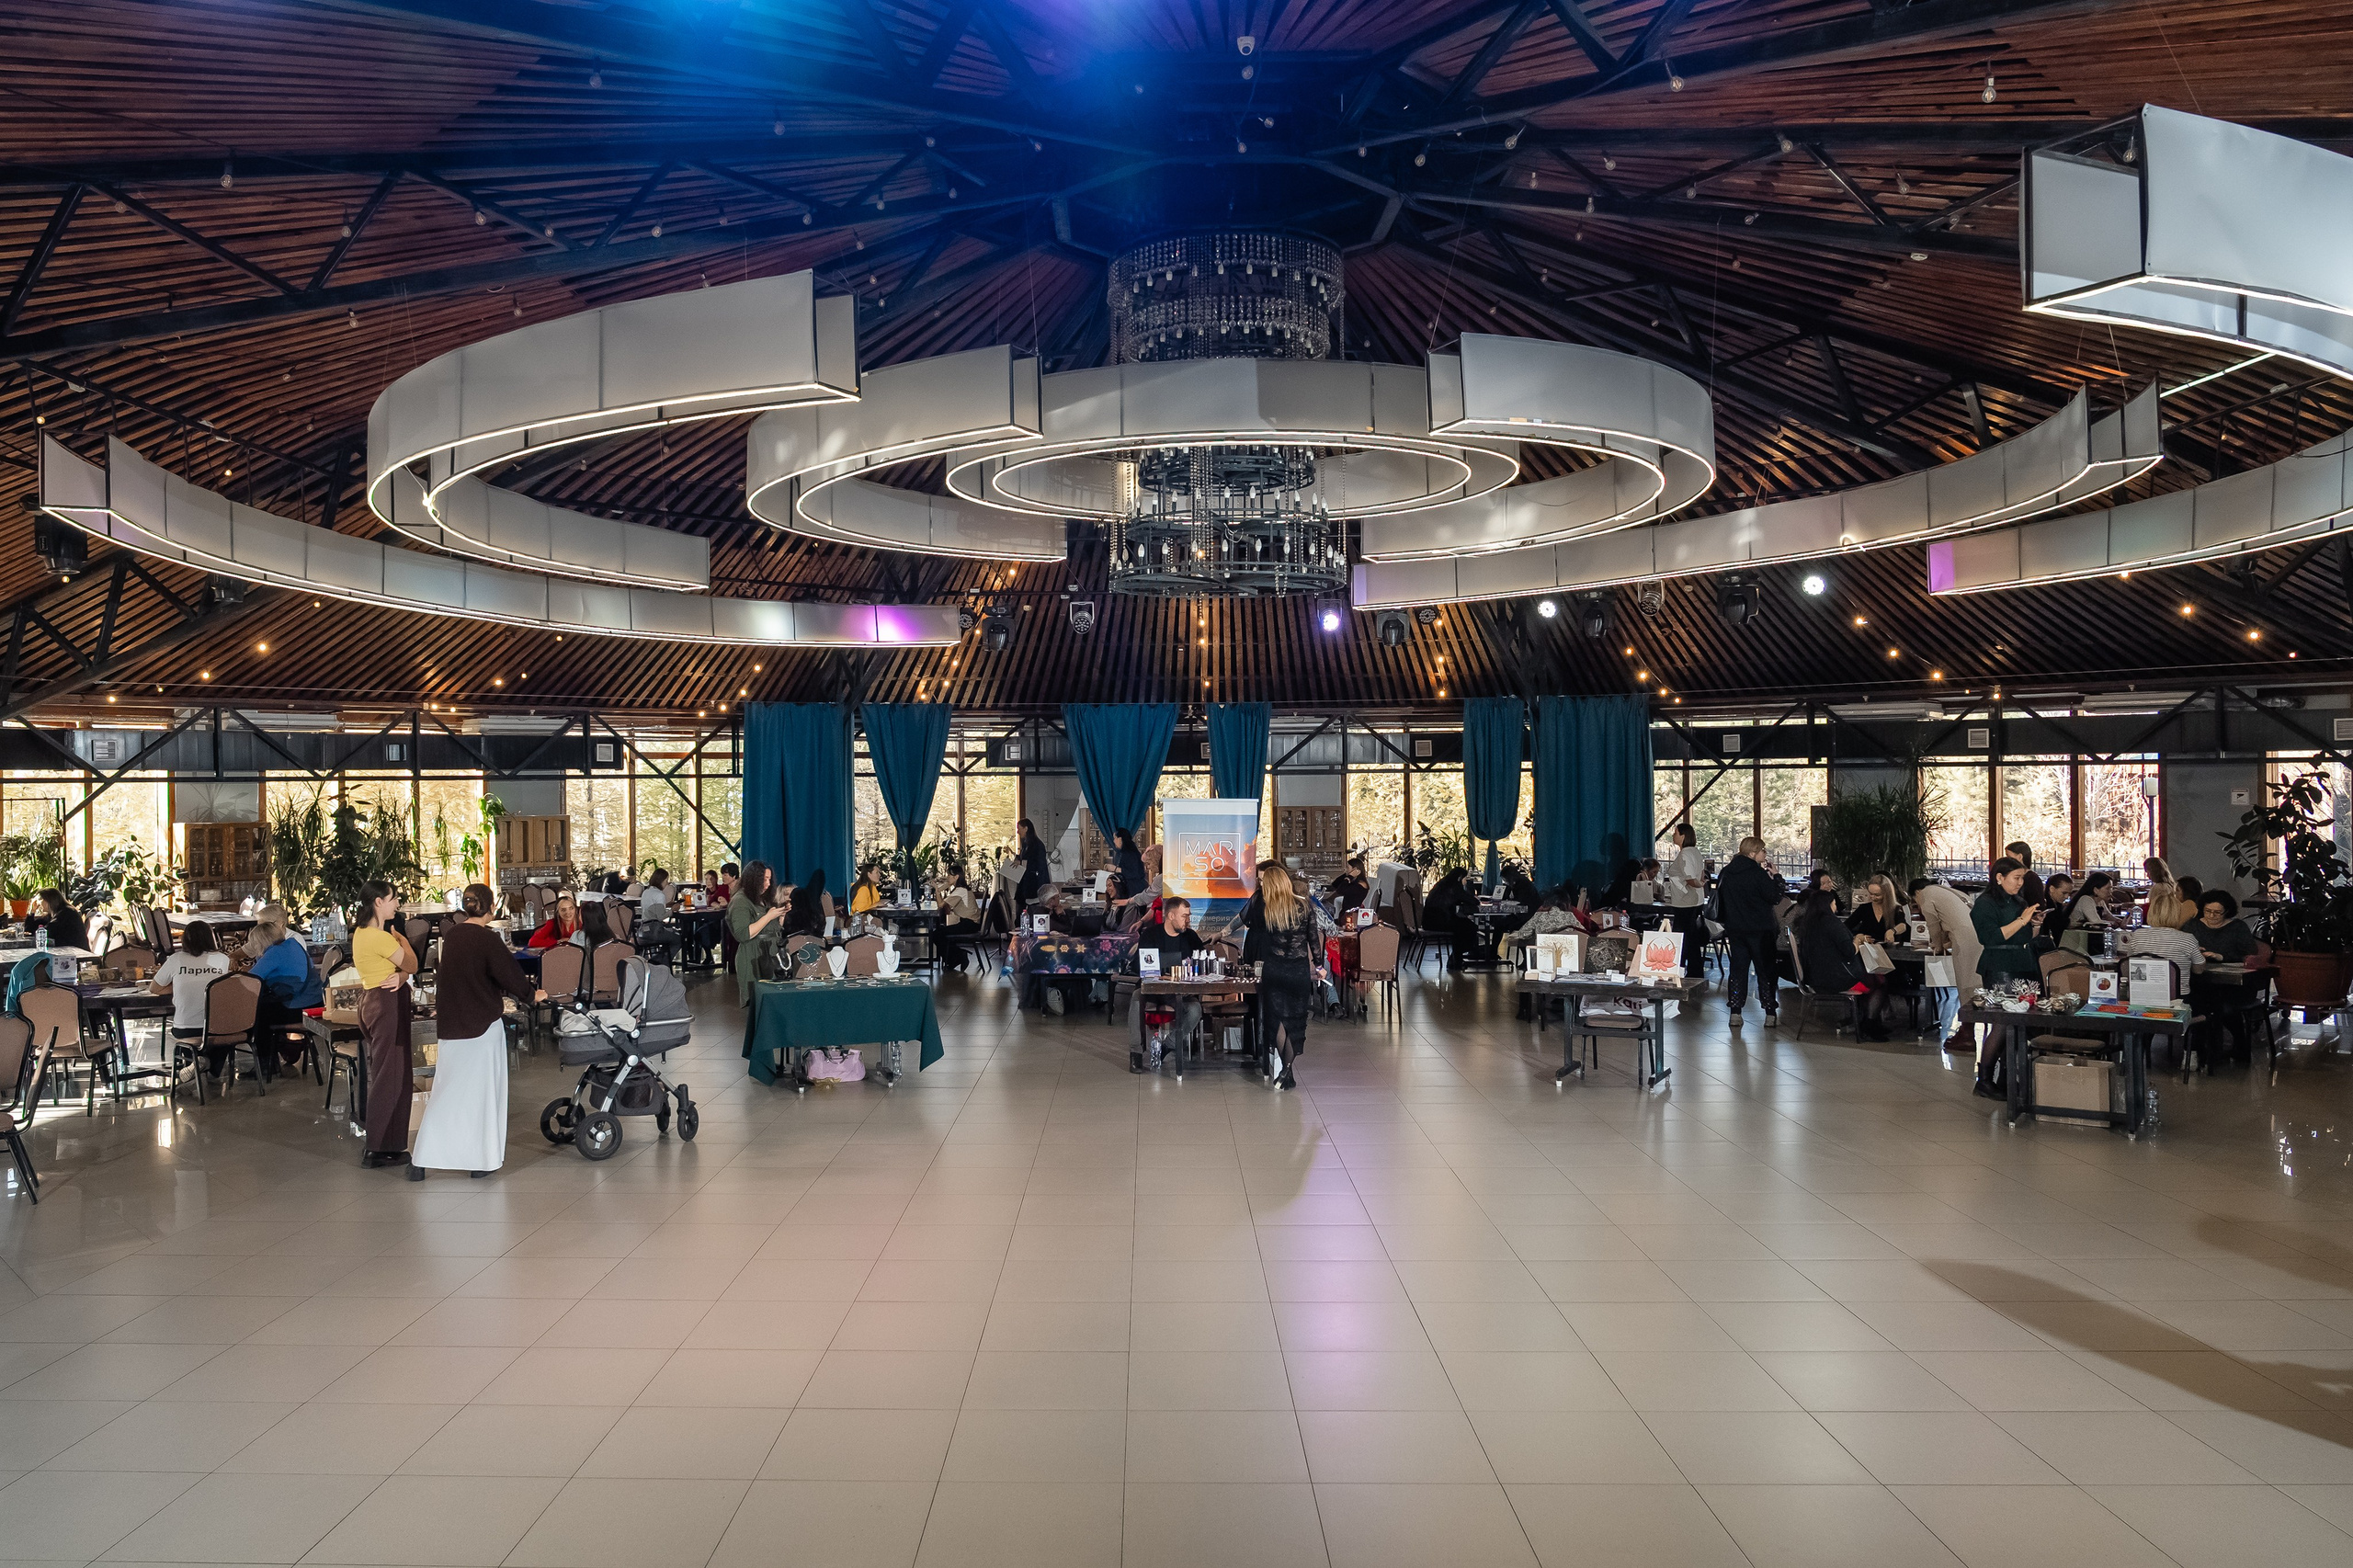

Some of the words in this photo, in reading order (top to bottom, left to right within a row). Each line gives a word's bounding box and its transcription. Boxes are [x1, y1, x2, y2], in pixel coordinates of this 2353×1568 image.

[1186, 840, 1233, 856] MAR
[1194, 857, 1225, 872] SO
[178, 966, 223, 976] Лариса
